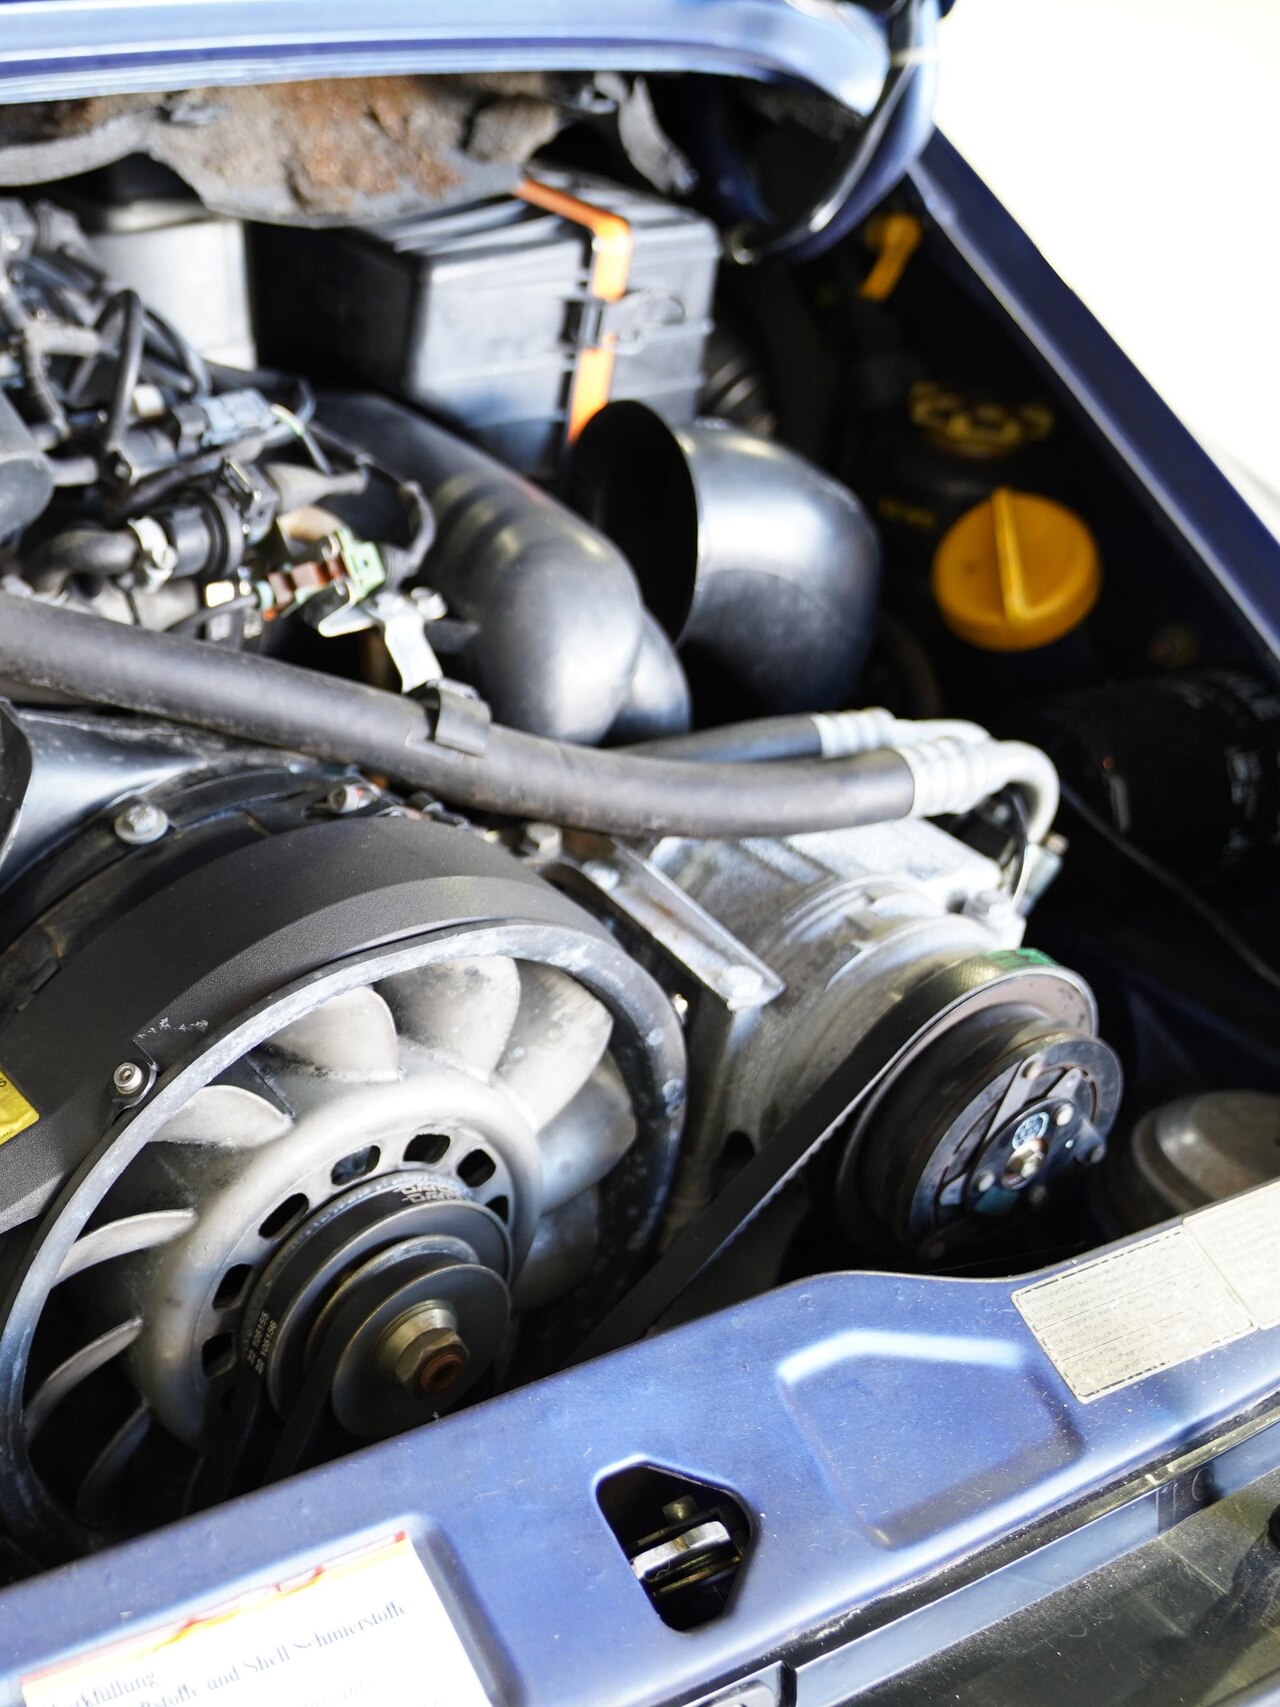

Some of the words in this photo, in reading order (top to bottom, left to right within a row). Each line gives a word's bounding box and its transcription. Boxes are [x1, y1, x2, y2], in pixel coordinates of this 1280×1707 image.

[206, 1665, 240, 1692] und
[243, 1644, 291, 1673] Shell
[293, 1600, 408, 1649] Schmierstoffe
